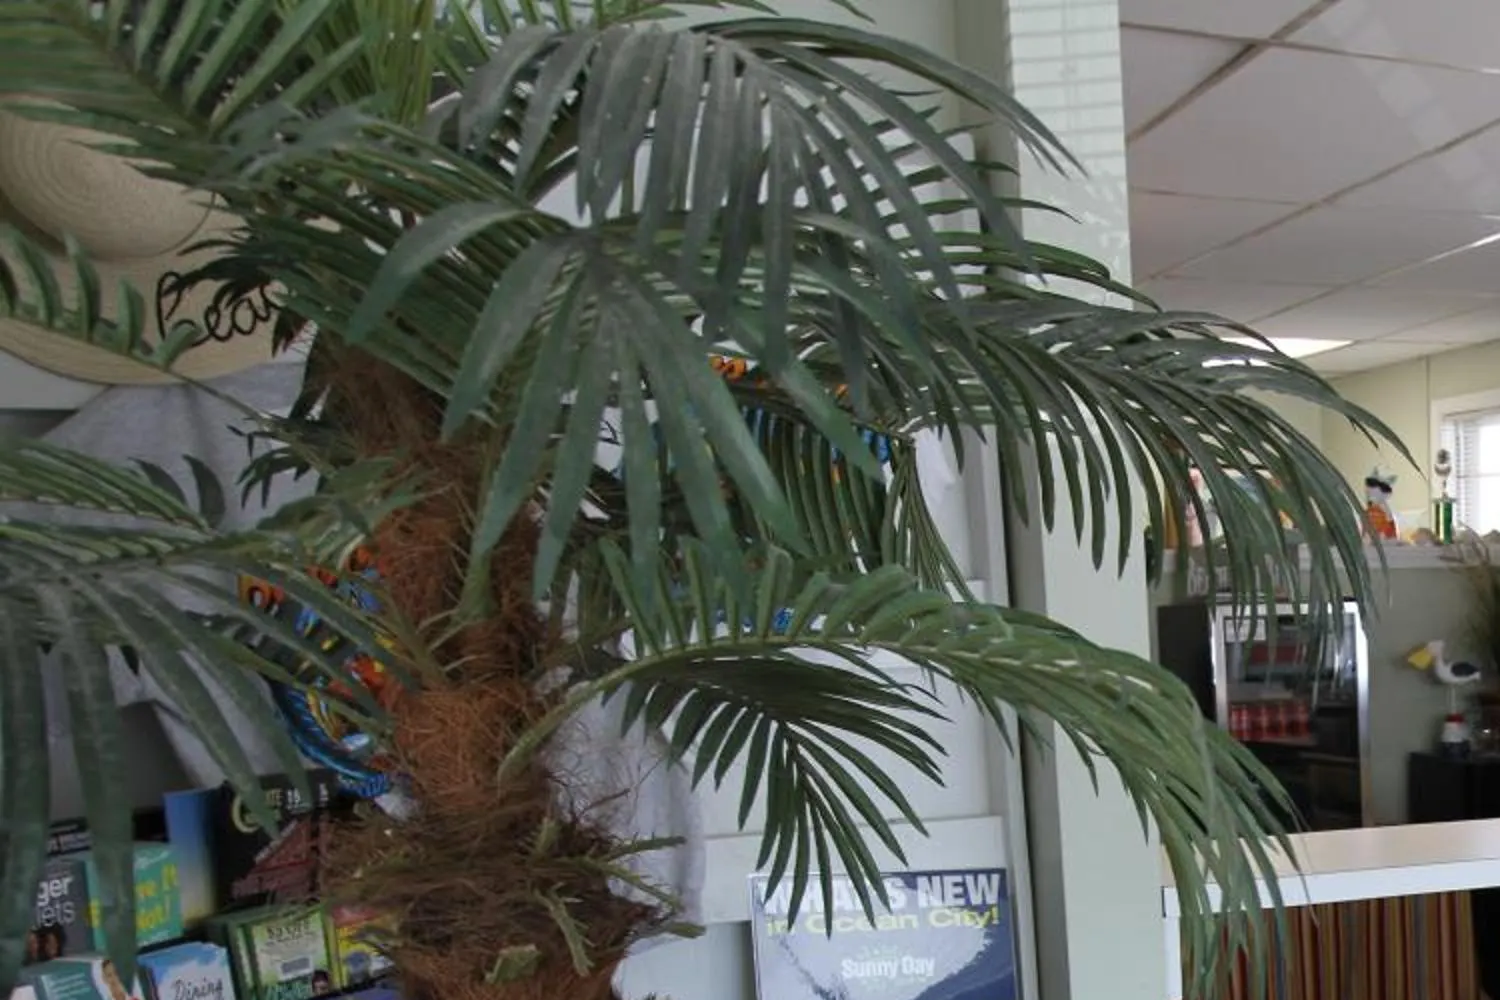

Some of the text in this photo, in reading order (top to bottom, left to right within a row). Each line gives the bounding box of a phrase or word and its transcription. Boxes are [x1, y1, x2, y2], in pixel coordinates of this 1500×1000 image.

[917, 873, 1000, 909] NEW
[928, 906, 998, 930] City!
[841, 955, 936, 979] Sunny Day
